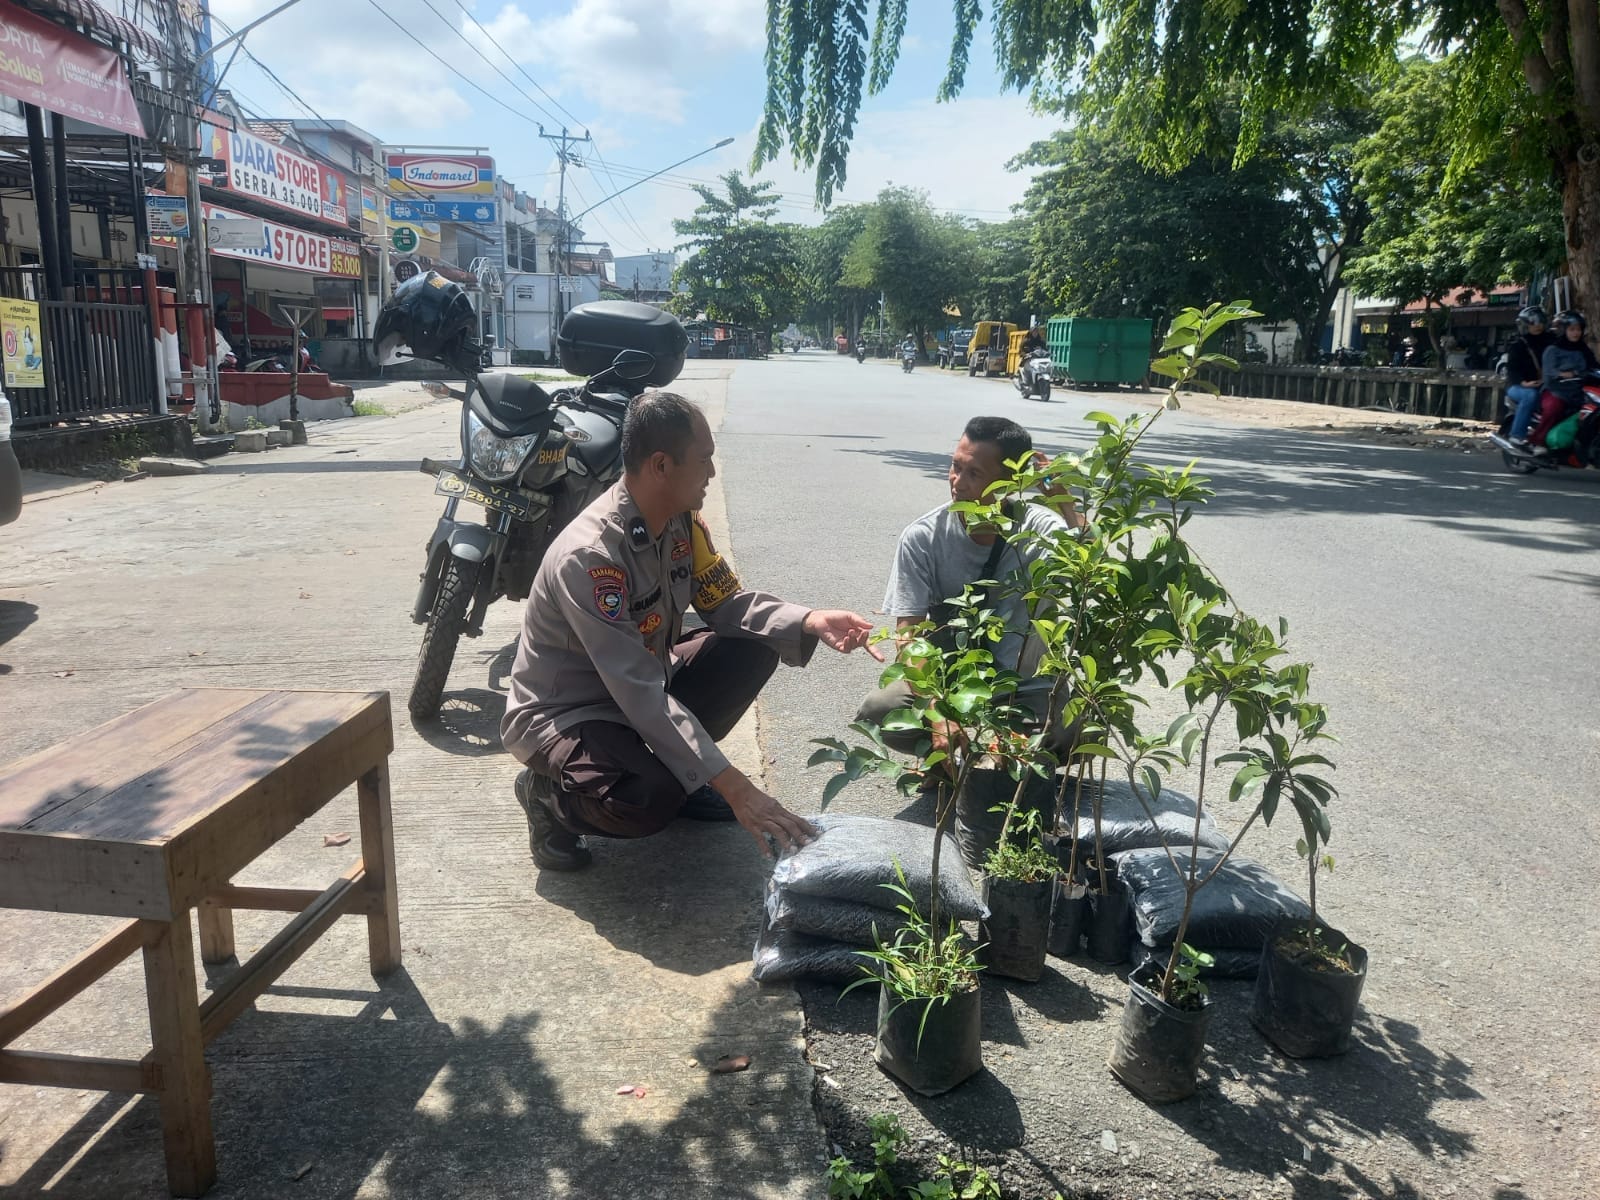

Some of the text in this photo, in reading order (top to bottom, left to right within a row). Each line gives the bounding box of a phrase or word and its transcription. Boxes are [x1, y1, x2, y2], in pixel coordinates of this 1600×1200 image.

[407, 167, 473, 181] Indomaret
[234, 168, 319, 214] SERBA 35.000
[331, 252, 361, 276] 35.000
